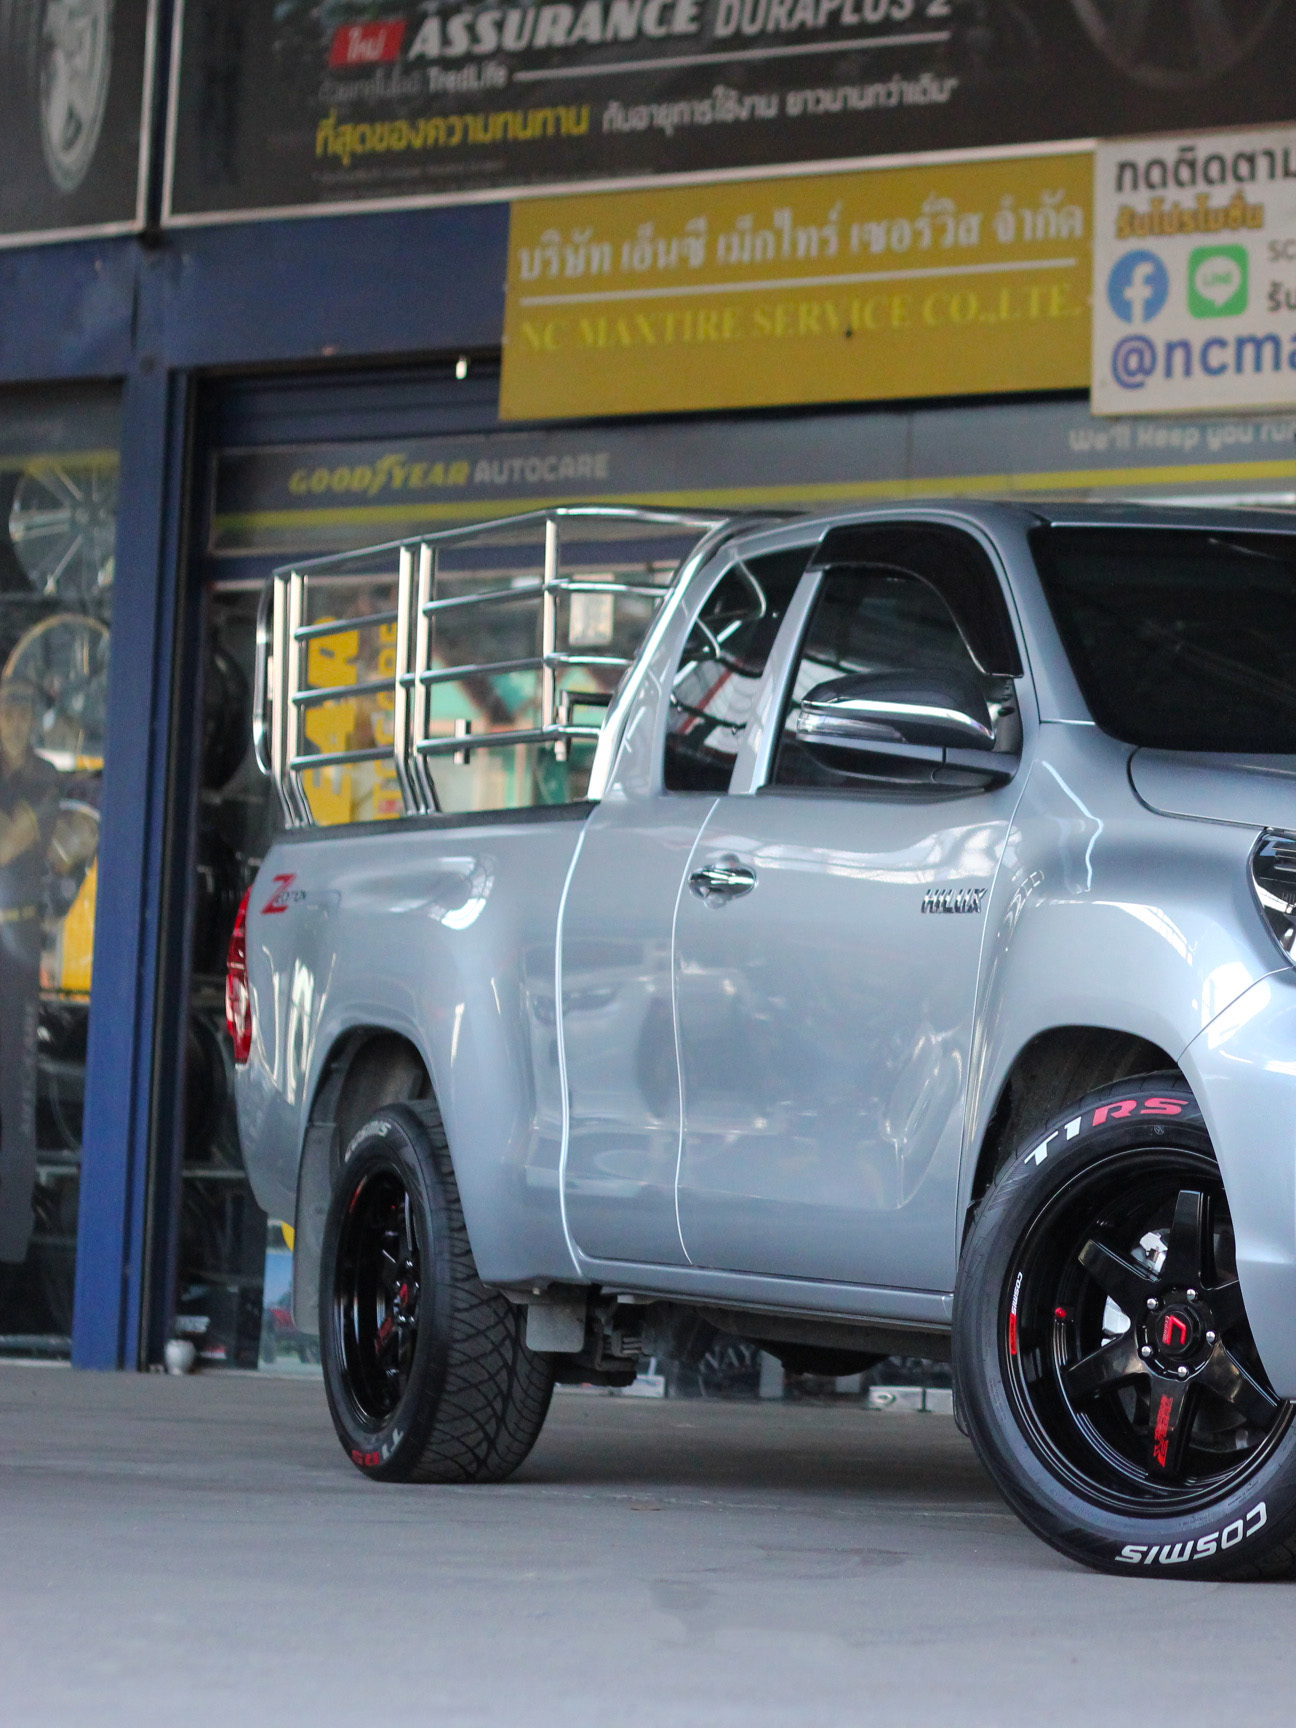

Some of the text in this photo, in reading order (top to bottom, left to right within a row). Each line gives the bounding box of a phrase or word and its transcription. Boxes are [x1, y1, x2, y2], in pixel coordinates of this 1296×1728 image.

[407, 0, 699, 61] ASSURANCE
[519, 225, 612, 281] บริษัท
[992, 187, 1085, 245] จำกัด
[522, 320, 567, 350] NC
[579, 307, 741, 348] MAXTIRE
[753, 294, 912, 341] SERVICE
[288, 452, 610, 498] GOODYEAR AUTOCARE
[921, 888, 987, 913] HILUX
[1114, 1501, 1268, 1565] COSMIS
